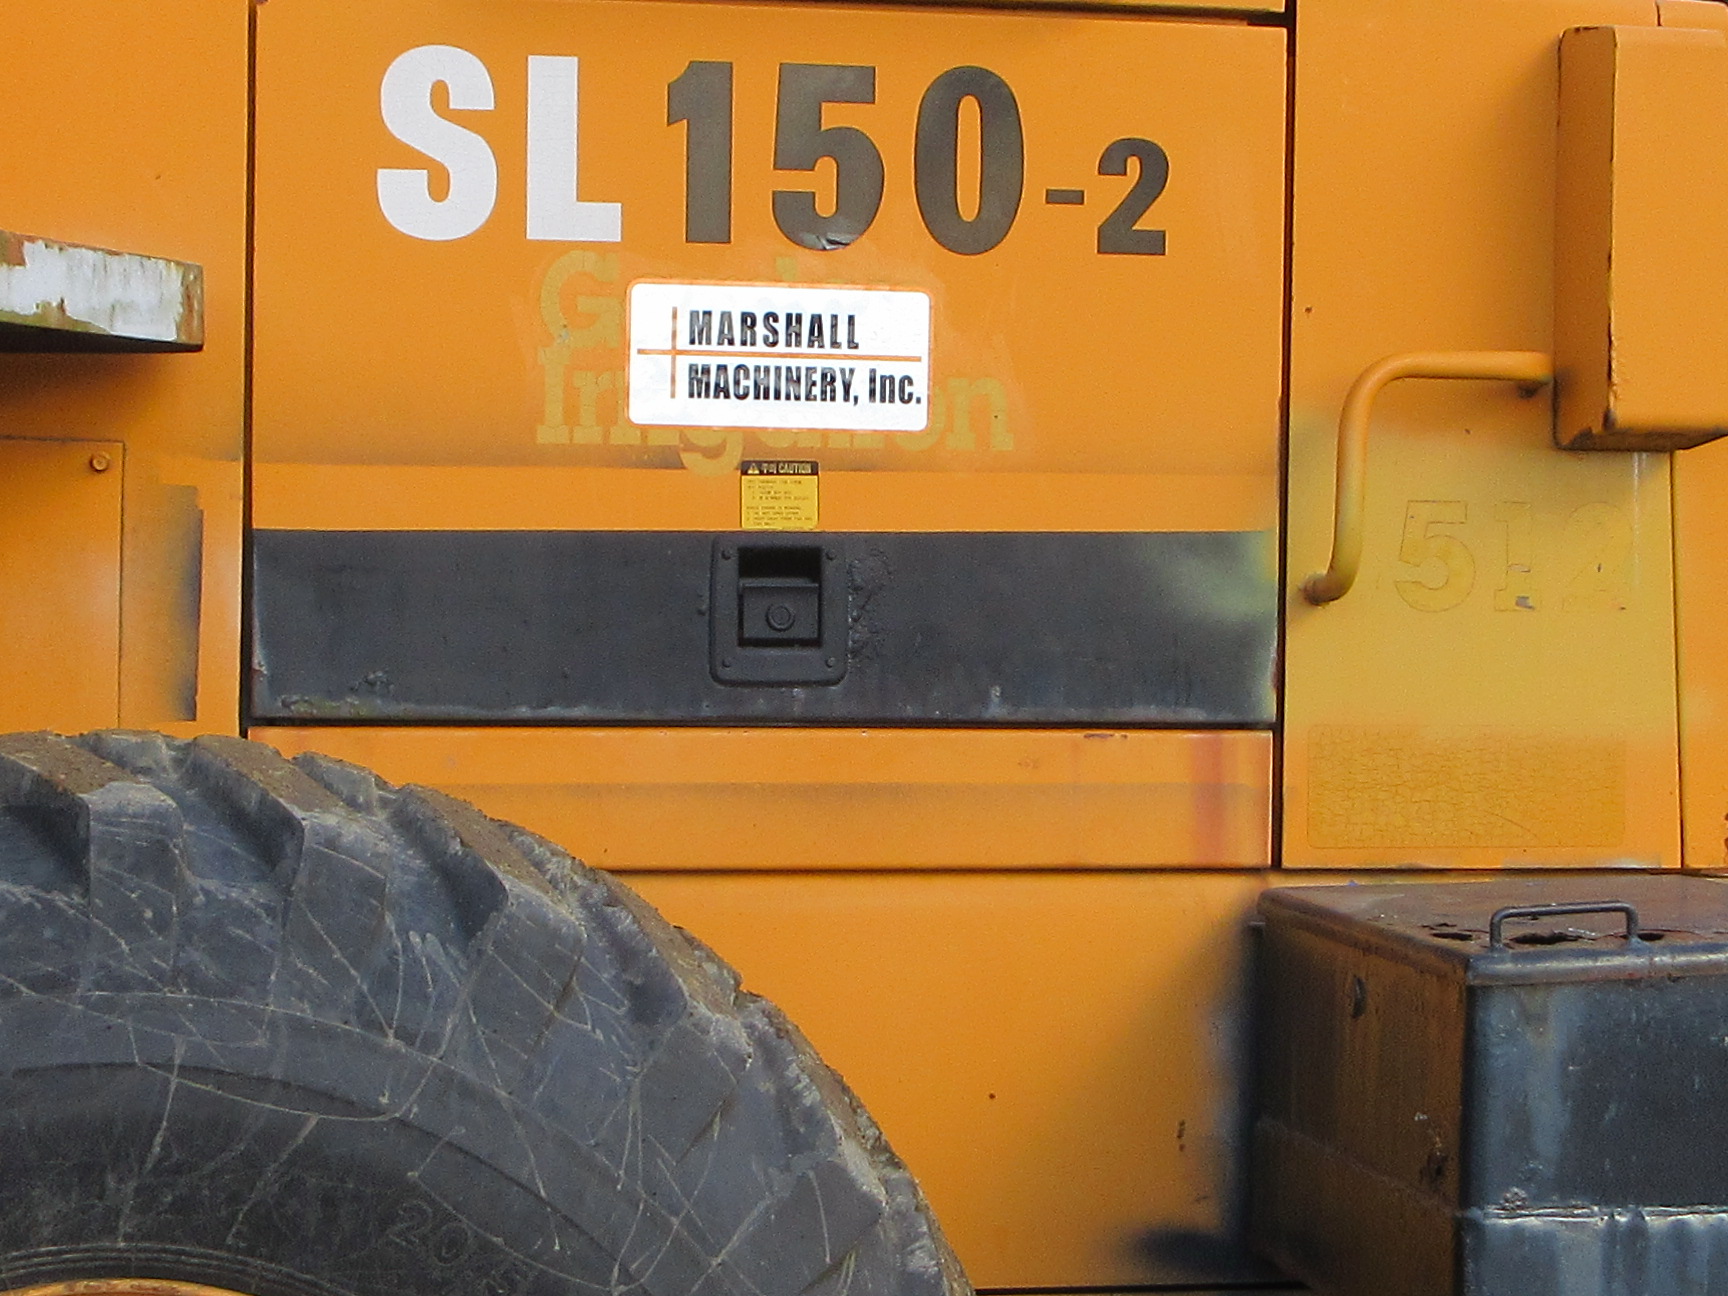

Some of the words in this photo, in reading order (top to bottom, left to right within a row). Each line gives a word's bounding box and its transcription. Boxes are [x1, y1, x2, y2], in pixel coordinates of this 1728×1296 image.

[688, 309, 860, 350] MARSHALL
[687, 363, 860, 407] MACHINERY,
[868, 367, 922, 405] Inc.
[777, 462, 812, 474] CAUTION
